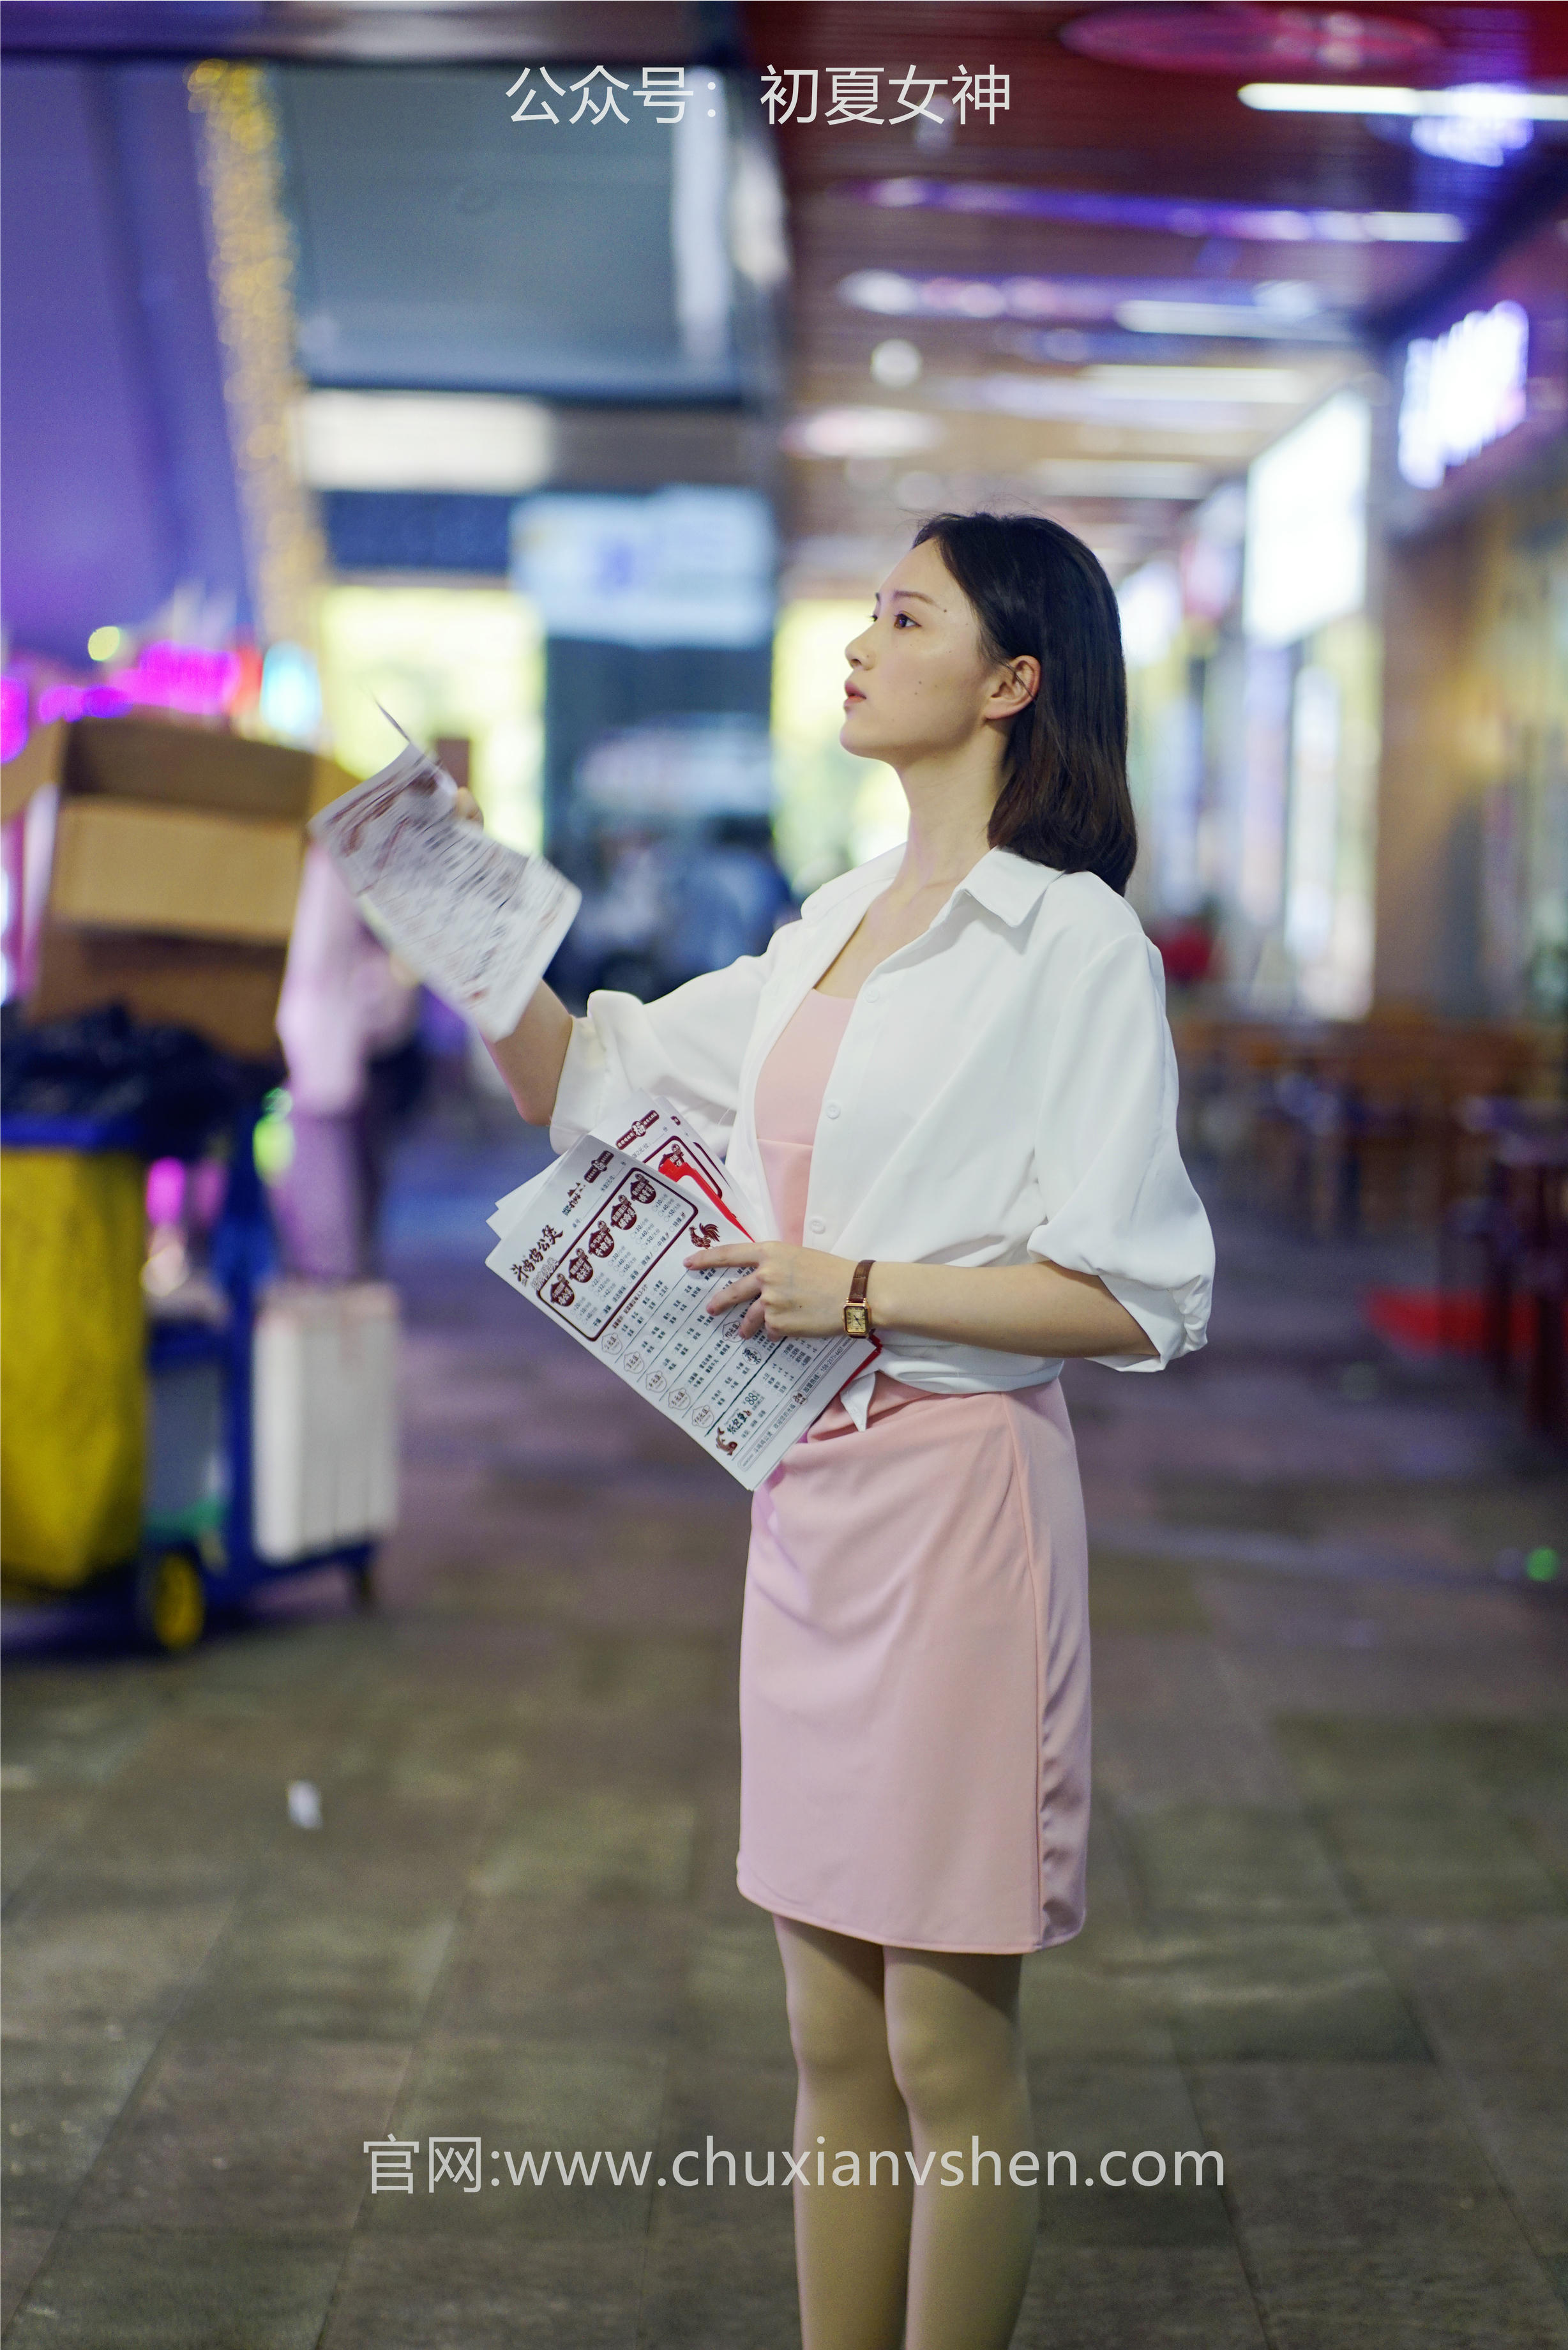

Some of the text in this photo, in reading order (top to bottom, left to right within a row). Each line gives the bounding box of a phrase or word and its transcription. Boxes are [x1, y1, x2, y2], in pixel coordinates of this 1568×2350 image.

[656, 1236, 667, 1247] 中辣
[672, 1217, 683, 1227] 特辣
[594, 1234, 615, 1259] 牛肉煲
[658, 1285, 669, 1298] 土豆片
[727, 1412, 748, 1435] 纸包鱼
